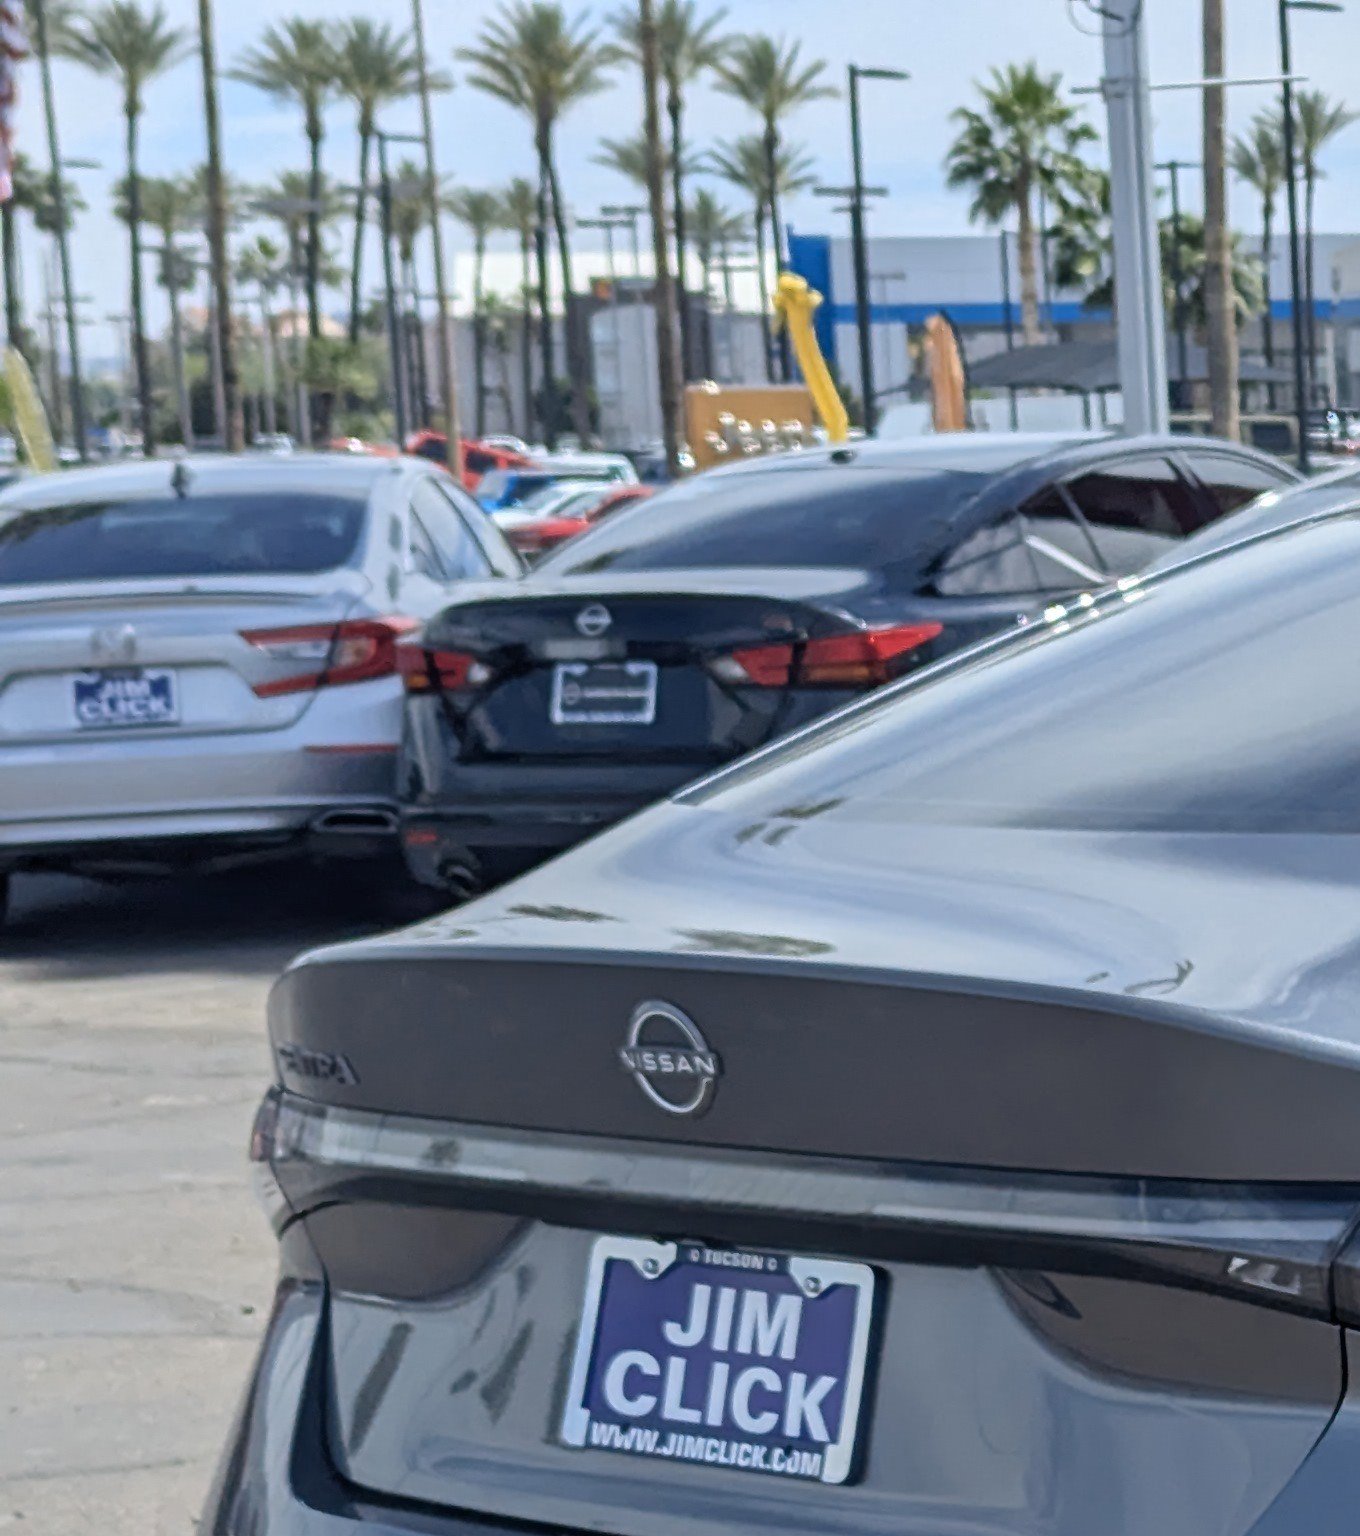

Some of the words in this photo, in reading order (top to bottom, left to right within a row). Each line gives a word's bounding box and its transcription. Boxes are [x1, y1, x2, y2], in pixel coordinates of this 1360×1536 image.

[620, 1048, 717, 1075] NISSAN
[703, 1248, 764, 1270] TUCSON
[663, 1282, 804, 1360] JIM
[604, 1349, 838, 1443] CLICK
[590, 1420, 823, 1477] WWW.JIMCLICK.COM
